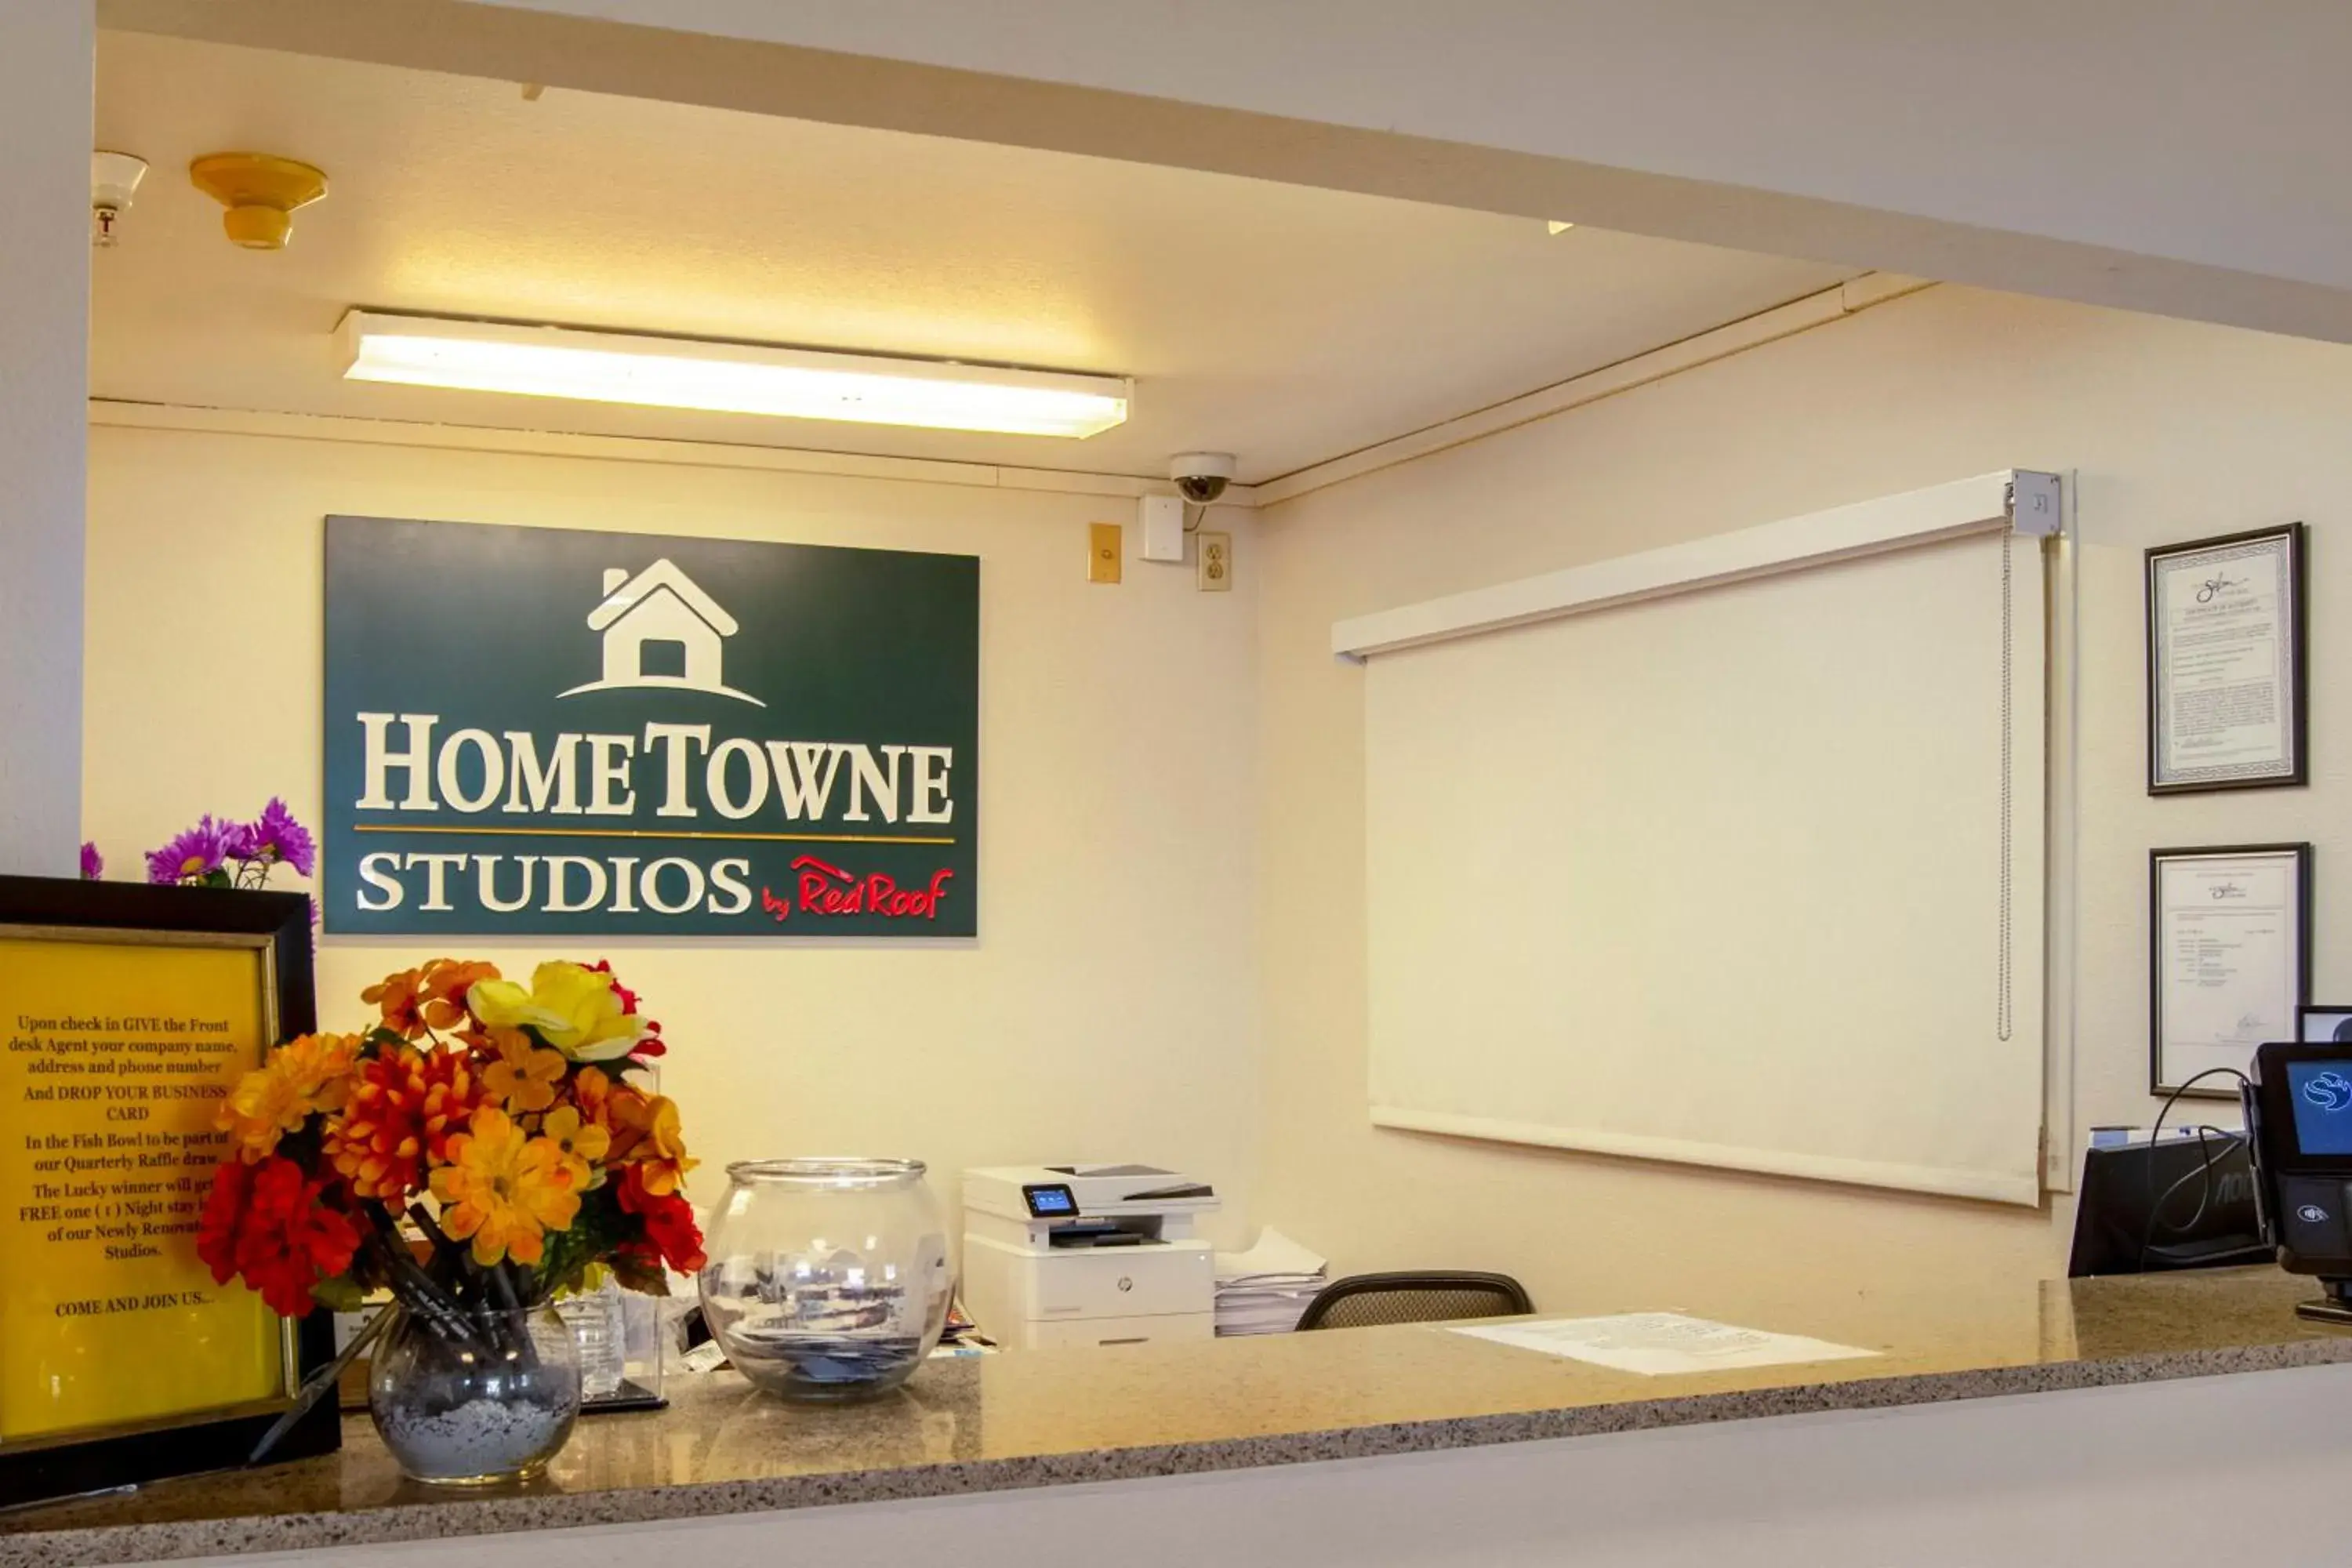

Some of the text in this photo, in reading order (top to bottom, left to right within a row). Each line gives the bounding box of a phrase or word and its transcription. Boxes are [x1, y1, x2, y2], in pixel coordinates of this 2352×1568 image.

[357, 851, 752, 914] STUDIOS
[762, 886, 790, 922] by
[18, 1015, 229, 1033] Upon check in GIVE the Front
[9, 1035, 42, 1052] desk
[46, 1036, 88, 1055] Agent
[91, 1040, 125, 1056] your
[128, 1042, 192, 1056] company
[27, 1057, 221, 1077] address and phone number
[24, 1084, 227, 1100] And DROP YOUR BUSINESS
[107, 1106, 150, 1121] CARD
[26, 1134, 42, 1150] In
[45, 1133, 69, 1149] the
[73, 1132, 103, 1149] Fish
[107, 1131, 143, 1148] Bowl
[146, 1133, 161, 1146] to
[163, 1131, 180, 1145] be
[183, 1131, 212, 1149] part
[34, 1160, 61, 1171] our
[64, 1152, 134, 1174] Quarterly
[138, 1151, 180, 1167] Raffle
[33, 1181, 60, 1200] The
[64, 1180, 107, 1200] Lucky
[111, 1178, 164, 1195] winner
[165, 1177, 191, 1192] will
[19, 1205, 61, 1222] FREE
[64, 1207, 92, 1219] one
[125, 1200, 163, 1218] Night
[167, 1200, 196, 1217] stay
[47, 1226, 63, 1243] of
[66, 1229, 93, 1241] our
[95, 1221, 139, 1240] Newly
[55, 1301, 102, 1319] COME
[104, 1296, 139, 1313] AND
[142, 1294, 179, 1310] JOIN
